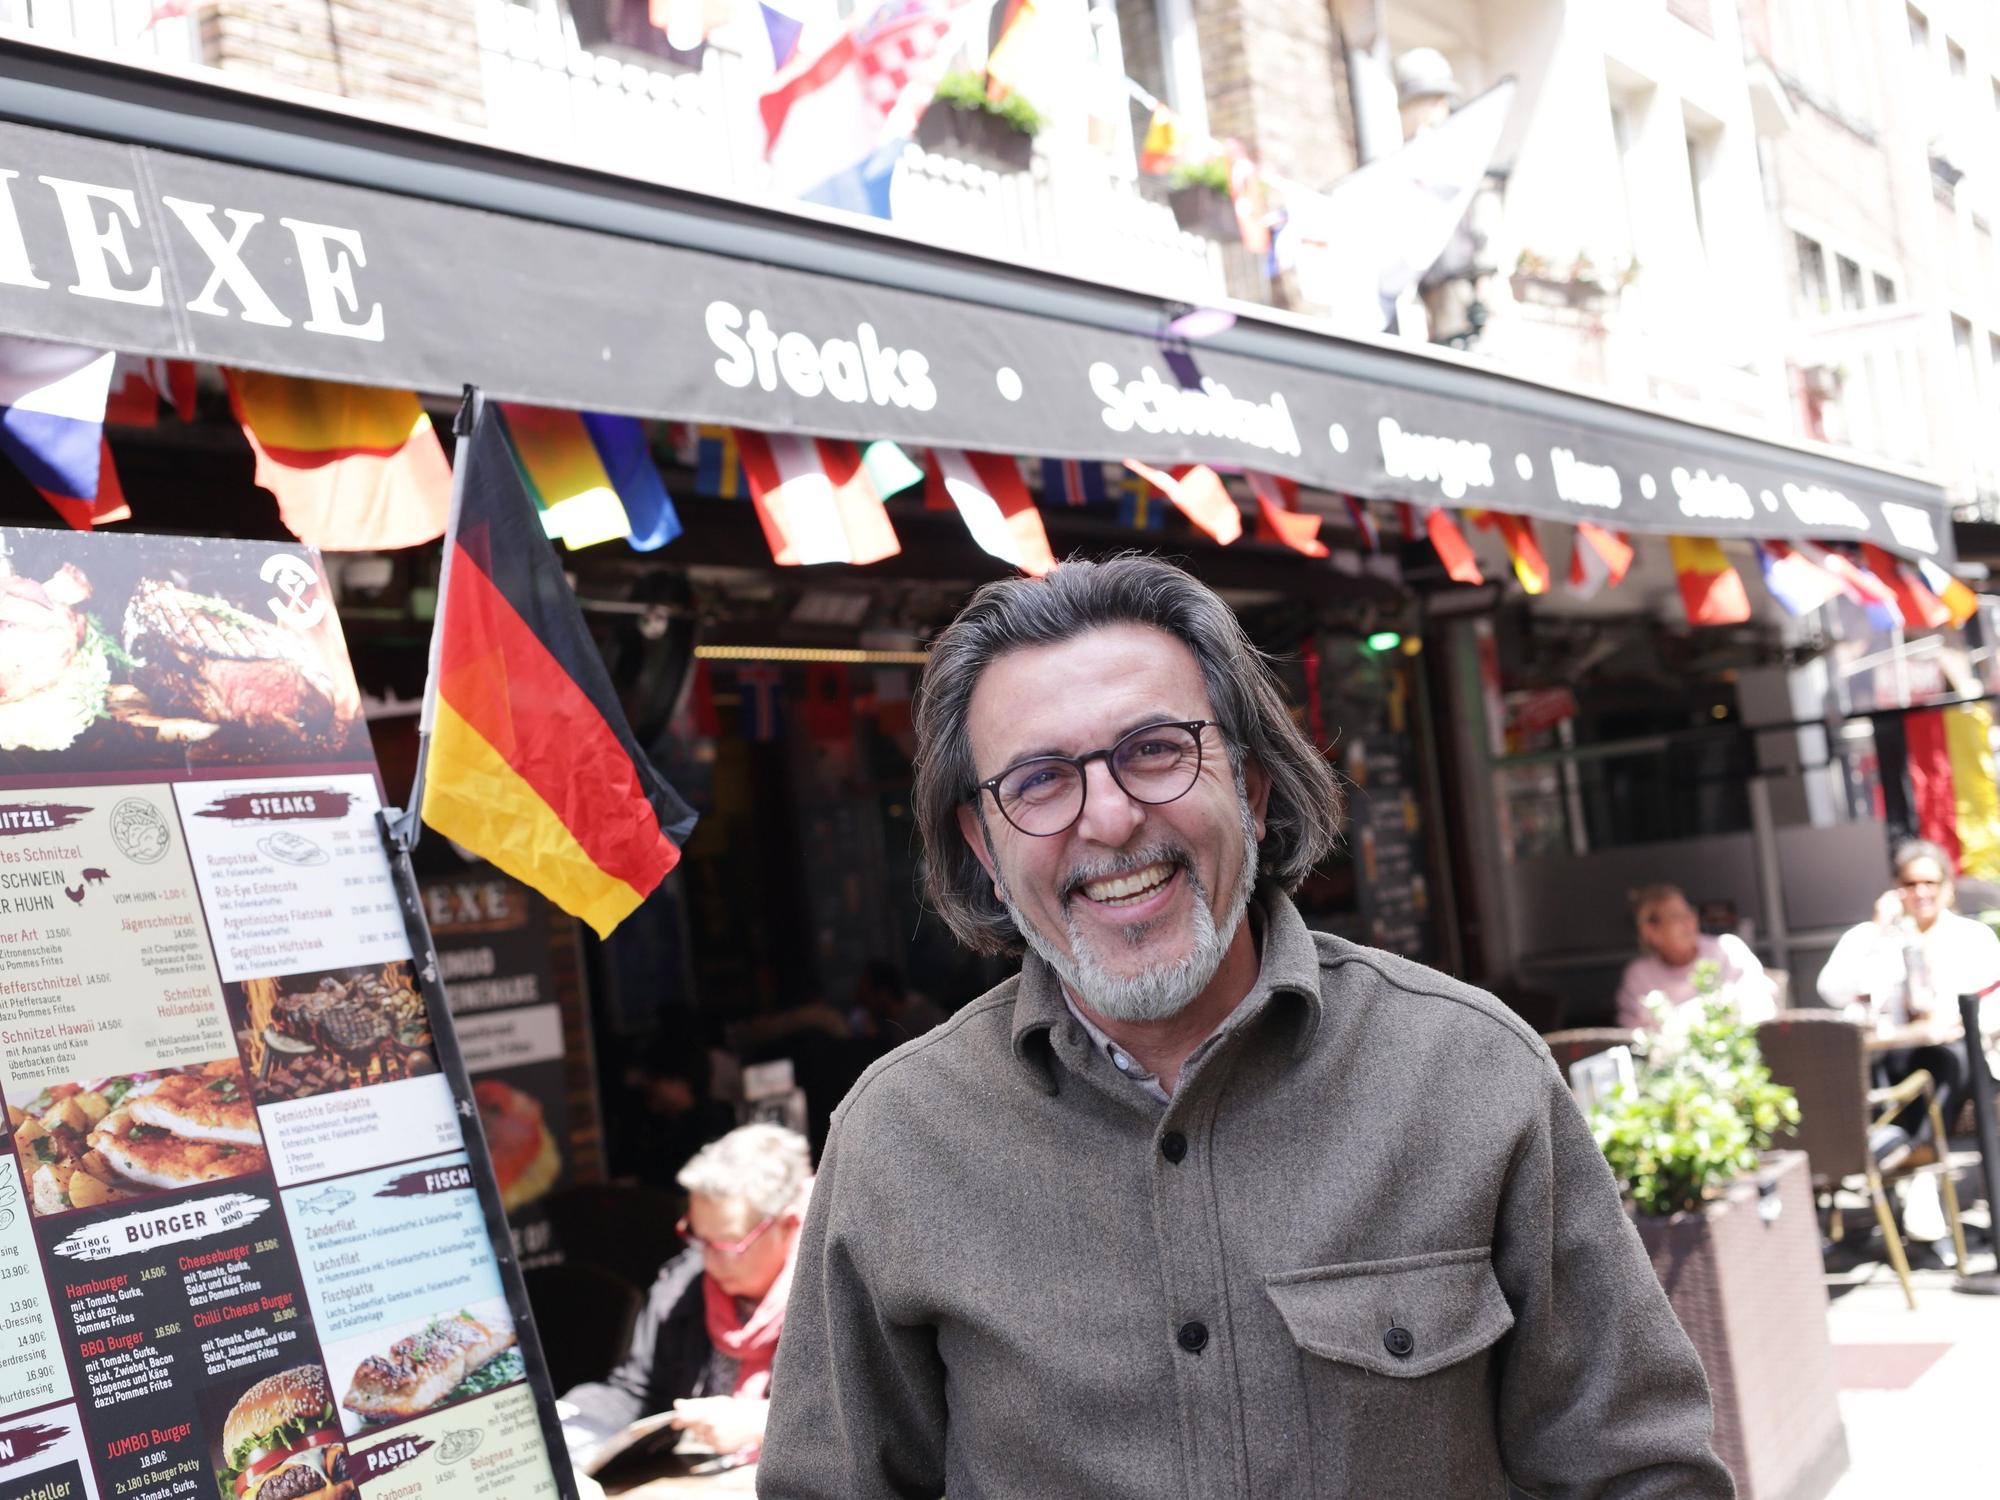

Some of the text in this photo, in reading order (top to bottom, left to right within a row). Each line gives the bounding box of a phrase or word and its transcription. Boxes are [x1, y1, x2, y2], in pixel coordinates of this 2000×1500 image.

[705, 301, 937, 411] Steaks
[250, 797, 316, 815] STEAKS
[0, 810, 55, 829] ITZEL
[24, 845, 83, 862] Schnitzel
[207, 854, 257, 867] Rumpsteak
[1, 870, 66, 889] SCHWEIN
[113, 890, 157, 904] VOM HUHN
[216, 884, 250, 898] Rib-Eye
[15, 895, 55, 912] HUHN
[121, 913, 194, 933] Jägerschnitzel
[22, 928, 39, 942] Art
[141, 946, 153, 955] mit
[6, 956, 65, 970] Pommes Frites
[154, 962, 206, 976] Pommes Frites
[10, 994, 62, 1008] Pfeffersauce
[164, 985, 212, 1002] Schnitzel
[18, 1006, 52, 1019] Pommes
[52, 1003, 76, 1015] Frites
[156, 1002, 215, 1018] Hollandaise
[2, 1025, 57, 1044] Schnitzel
[58, 1019, 95, 1037] Hawaii
[144, 1031, 223, 1047] mit Hollandaise Sauce
[6, 1037, 89, 1057] mit Ananas und Käse
[9, 1052, 76, 1070] überbacken dazu
[12, 1064, 70, 1081] Pommes Frites
[274, 1107, 323, 1124] Gemischte
[291, 1152, 315, 1162] Person
[295, 1161, 326, 1173] Personen
[425, 1168, 470, 1191] FISCH
[125, 1211, 208, 1243] BURGER
[221, 1211, 244, 1227] RIND
[305, 1218, 357, 1240] Zanderfilet
[66, 1235, 111, 1253] mit 180 G
[89, 1246, 112, 1257] Patty
[179, 1245, 250, 1271] Cheeseburger
[313, 1251, 360, 1272] Lachsfilet
[1, 1264, 30, 1280] 13.90€
[66, 1265, 167, 1298] Hamburger 14.50€
[184, 1260, 251, 1284] mit Tomate, Gurke,
[186, 1275, 242, 1296] Salat und Käse
[190, 1281, 262, 1307] dazu Pommes Frites
[321, 1283, 374, 1304] Fischplatte
[10, 1296, 39, 1313] 13.90€
[71, 1287, 144, 1313] mit Tomate, Gurke,
[73, 1306, 117, 1324] Salat dazu
[193, 1293, 294, 1328] Chilli Cheese Burger
[76, 1313, 135, 1336] Pommes Frites
[18, 1331, 47, 1348] 14.90€
[80, 1338, 106, 1359] BBQ
[107, 1331, 144, 1351] Burger
[201, 1326, 269, 1352] mit Tomate, Gurke,
[203, 1330, 298, 1364] Salat, Jalapenos und Käse
[86, 1345, 159, 1373] mit Tomate, Gurke,
[207, 1347, 280, 1376] dazu Pommes Frites
[26, 1365, 55, 1382] 16.90€
[88, 1354, 175, 1385] Salat, Zwiebel, Bacon
[92, 1367, 169, 1397] Jalapenos und Käse
[94, 1378, 173, 1409] dazu Pommes Frites
[107, 1422, 192, 1460] JUMBO Burger
[140, 1450, 168, 1469] 18.90€
[366, 1440, 418, 1472] PASTA
[470, 1447, 513, 1470] Bolognese
[115, 1459, 200, 1495] 2x 180 G Burger Patty
[172, 1479, 198, 1494] Gurke,
